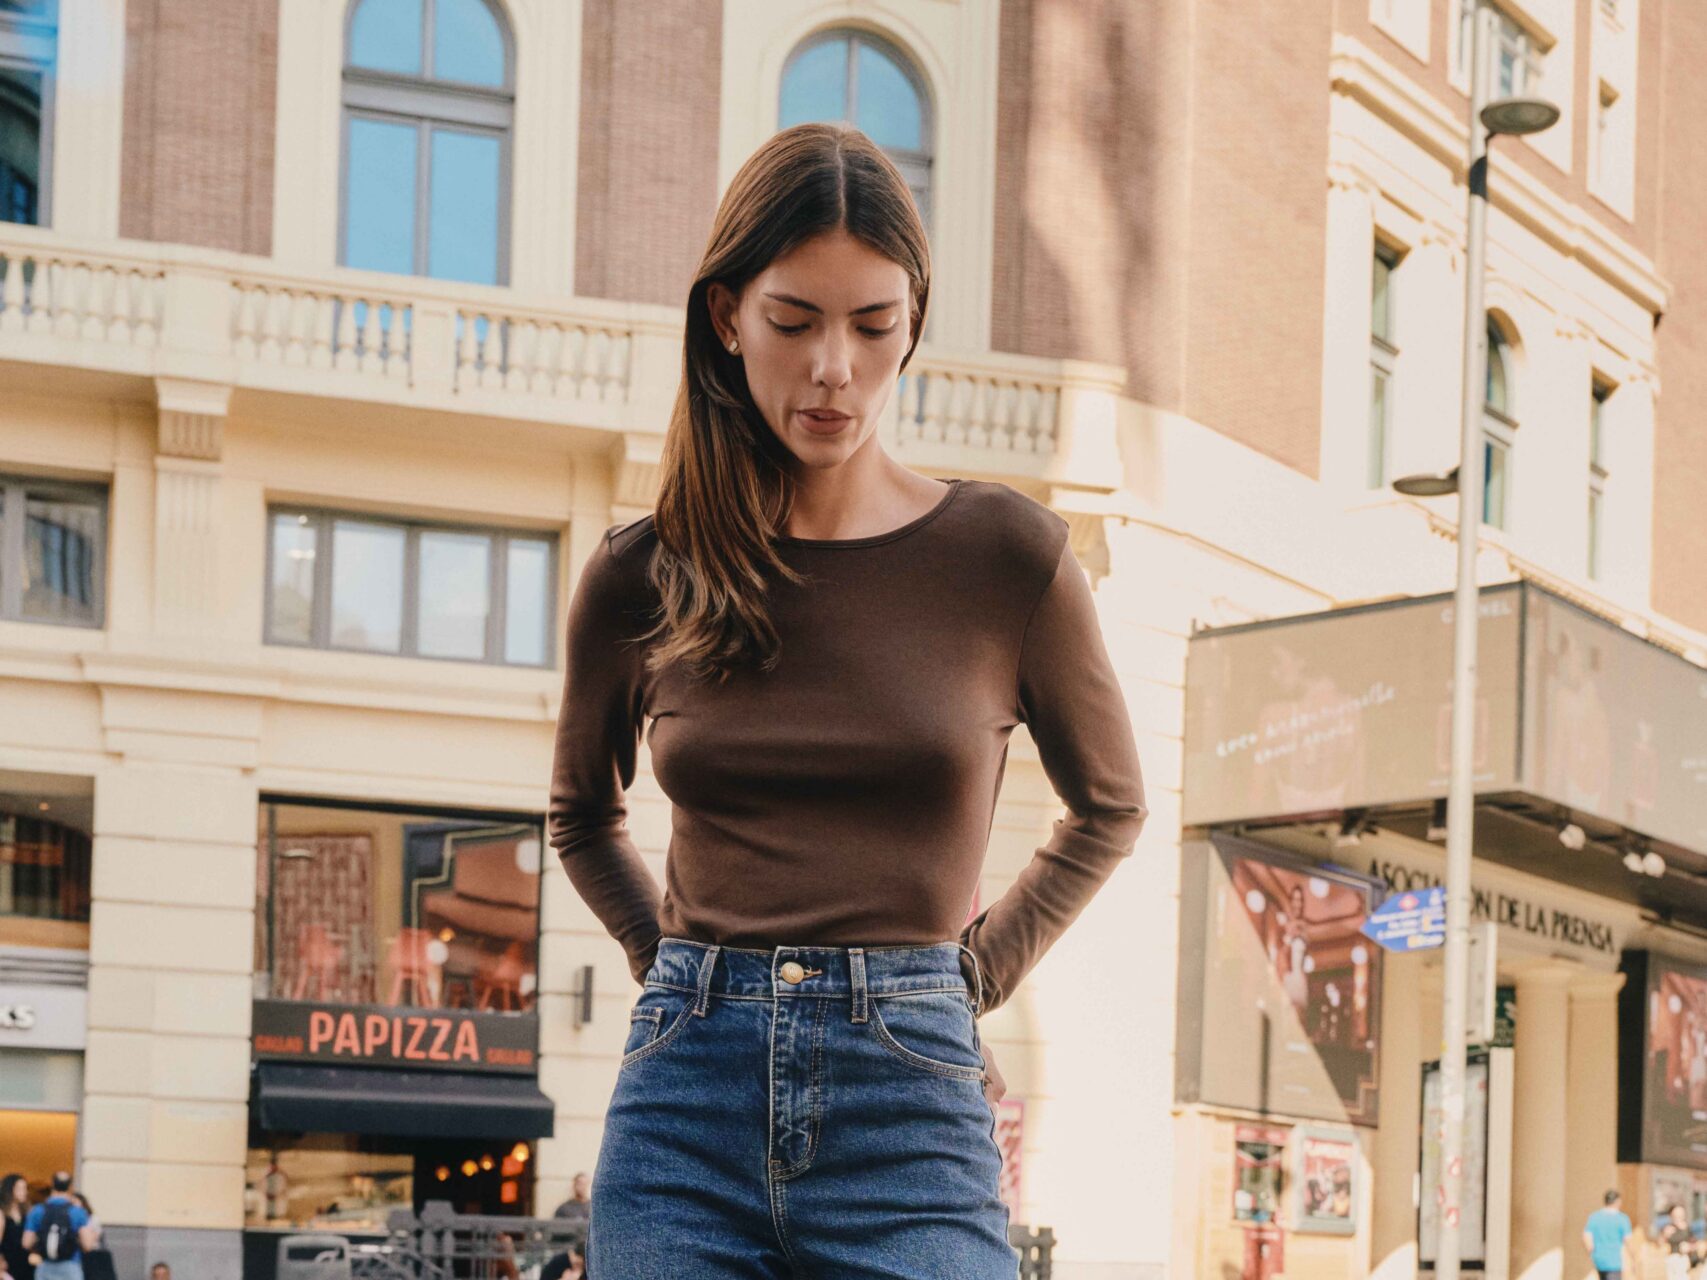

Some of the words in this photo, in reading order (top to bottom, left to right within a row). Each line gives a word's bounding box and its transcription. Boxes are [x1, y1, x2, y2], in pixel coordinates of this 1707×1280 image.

[1497, 894, 1519, 927] DE
[1524, 903, 1547, 936] LA
[1551, 909, 1615, 954] PRENSA
[308, 1011, 480, 1062] PAPIZZA
